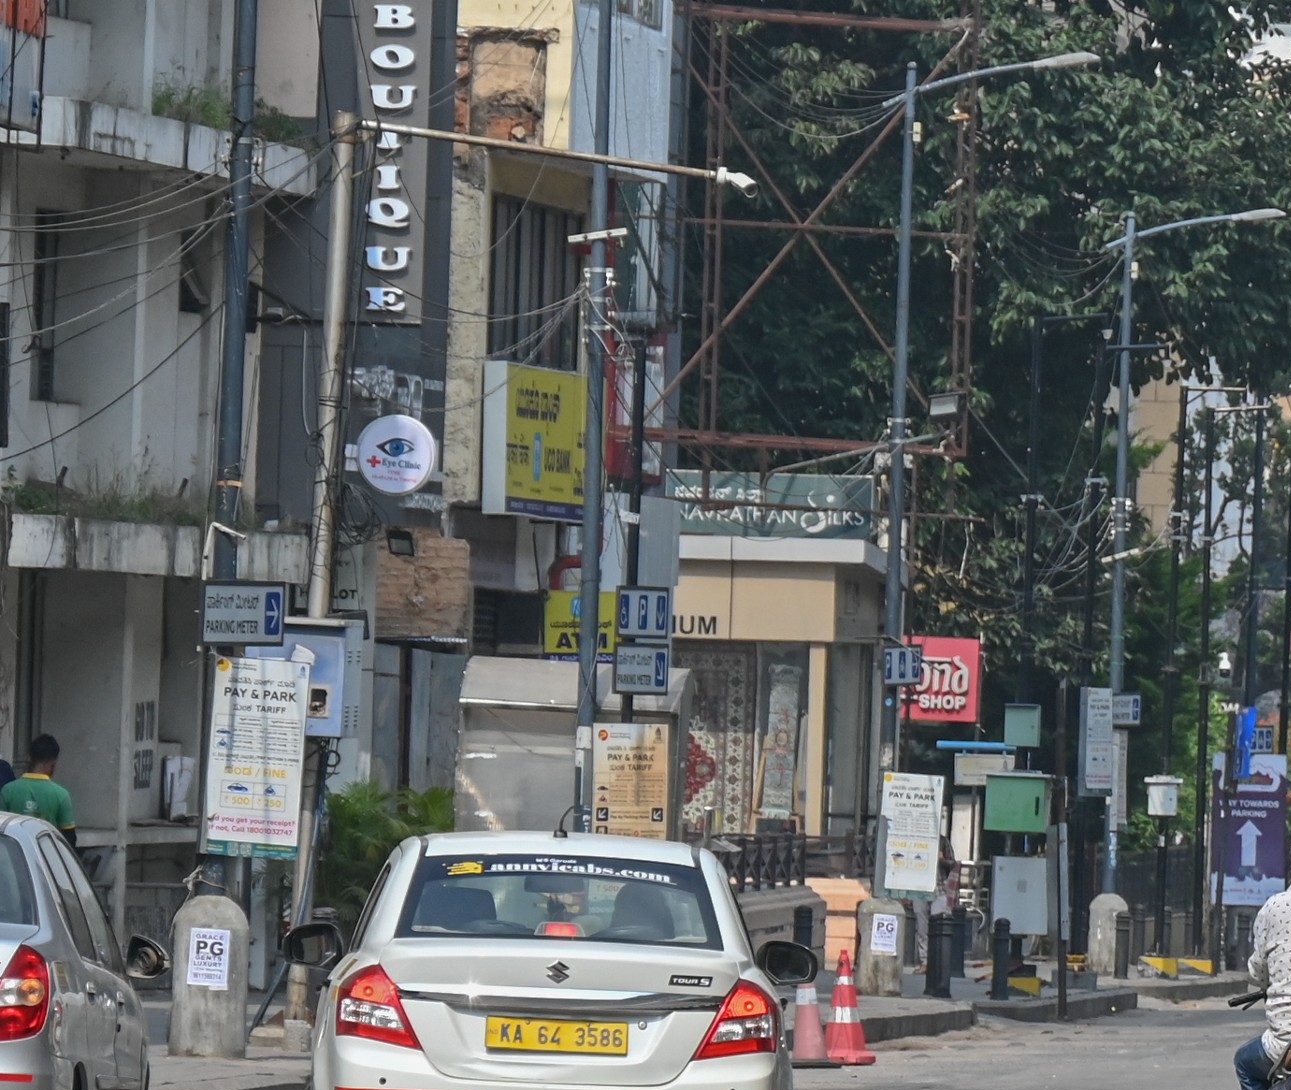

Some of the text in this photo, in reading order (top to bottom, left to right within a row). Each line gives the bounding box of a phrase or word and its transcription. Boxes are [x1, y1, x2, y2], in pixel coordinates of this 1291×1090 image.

[381, 459, 421, 470] Eye Clinic
[544, 448, 571, 473] UCO BANK
[206, 619, 259, 635] PARKING METER
[617, 673, 652, 686] PARKING METER
[223, 686, 297, 702] PAY & PARK
[918, 693, 967, 710] SHOP
[255, 705, 287, 714] TARIFF
[607, 753, 655, 762] PAY & PARK
[263, 768, 288, 779] FINE
[627, 764, 653, 772] TARIFF
[231, 796, 250, 805] 500
[888, 791, 936, 801] PAY & PARK
[264, 799, 282, 807] 250
[1239, 800, 1280, 808] TOWARDS
[1231, 809, 1268, 818] PARKING
[222, 815, 235, 824] you
[236, 817, 248, 825] get
[249, 818, 266, 827] your
[266, 819, 296, 828] receipt?
[231, 825, 245, 833] Call
[246, 826, 293, 837] 18001032747
[490, 862, 672, 884] annvicabs.com
[877, 921, 894, 933] PG
[195, 933, 225, 941] GRACE
[195, 940, 225, 957] PG
[193, 960, 223, 968] LUXURY
[699, 978, 711, 986] S
[500, 1023, 523, 1043] KA
[537, 1026, 561, 1046] 64
[575, 1028, 624, 1048] 3586
